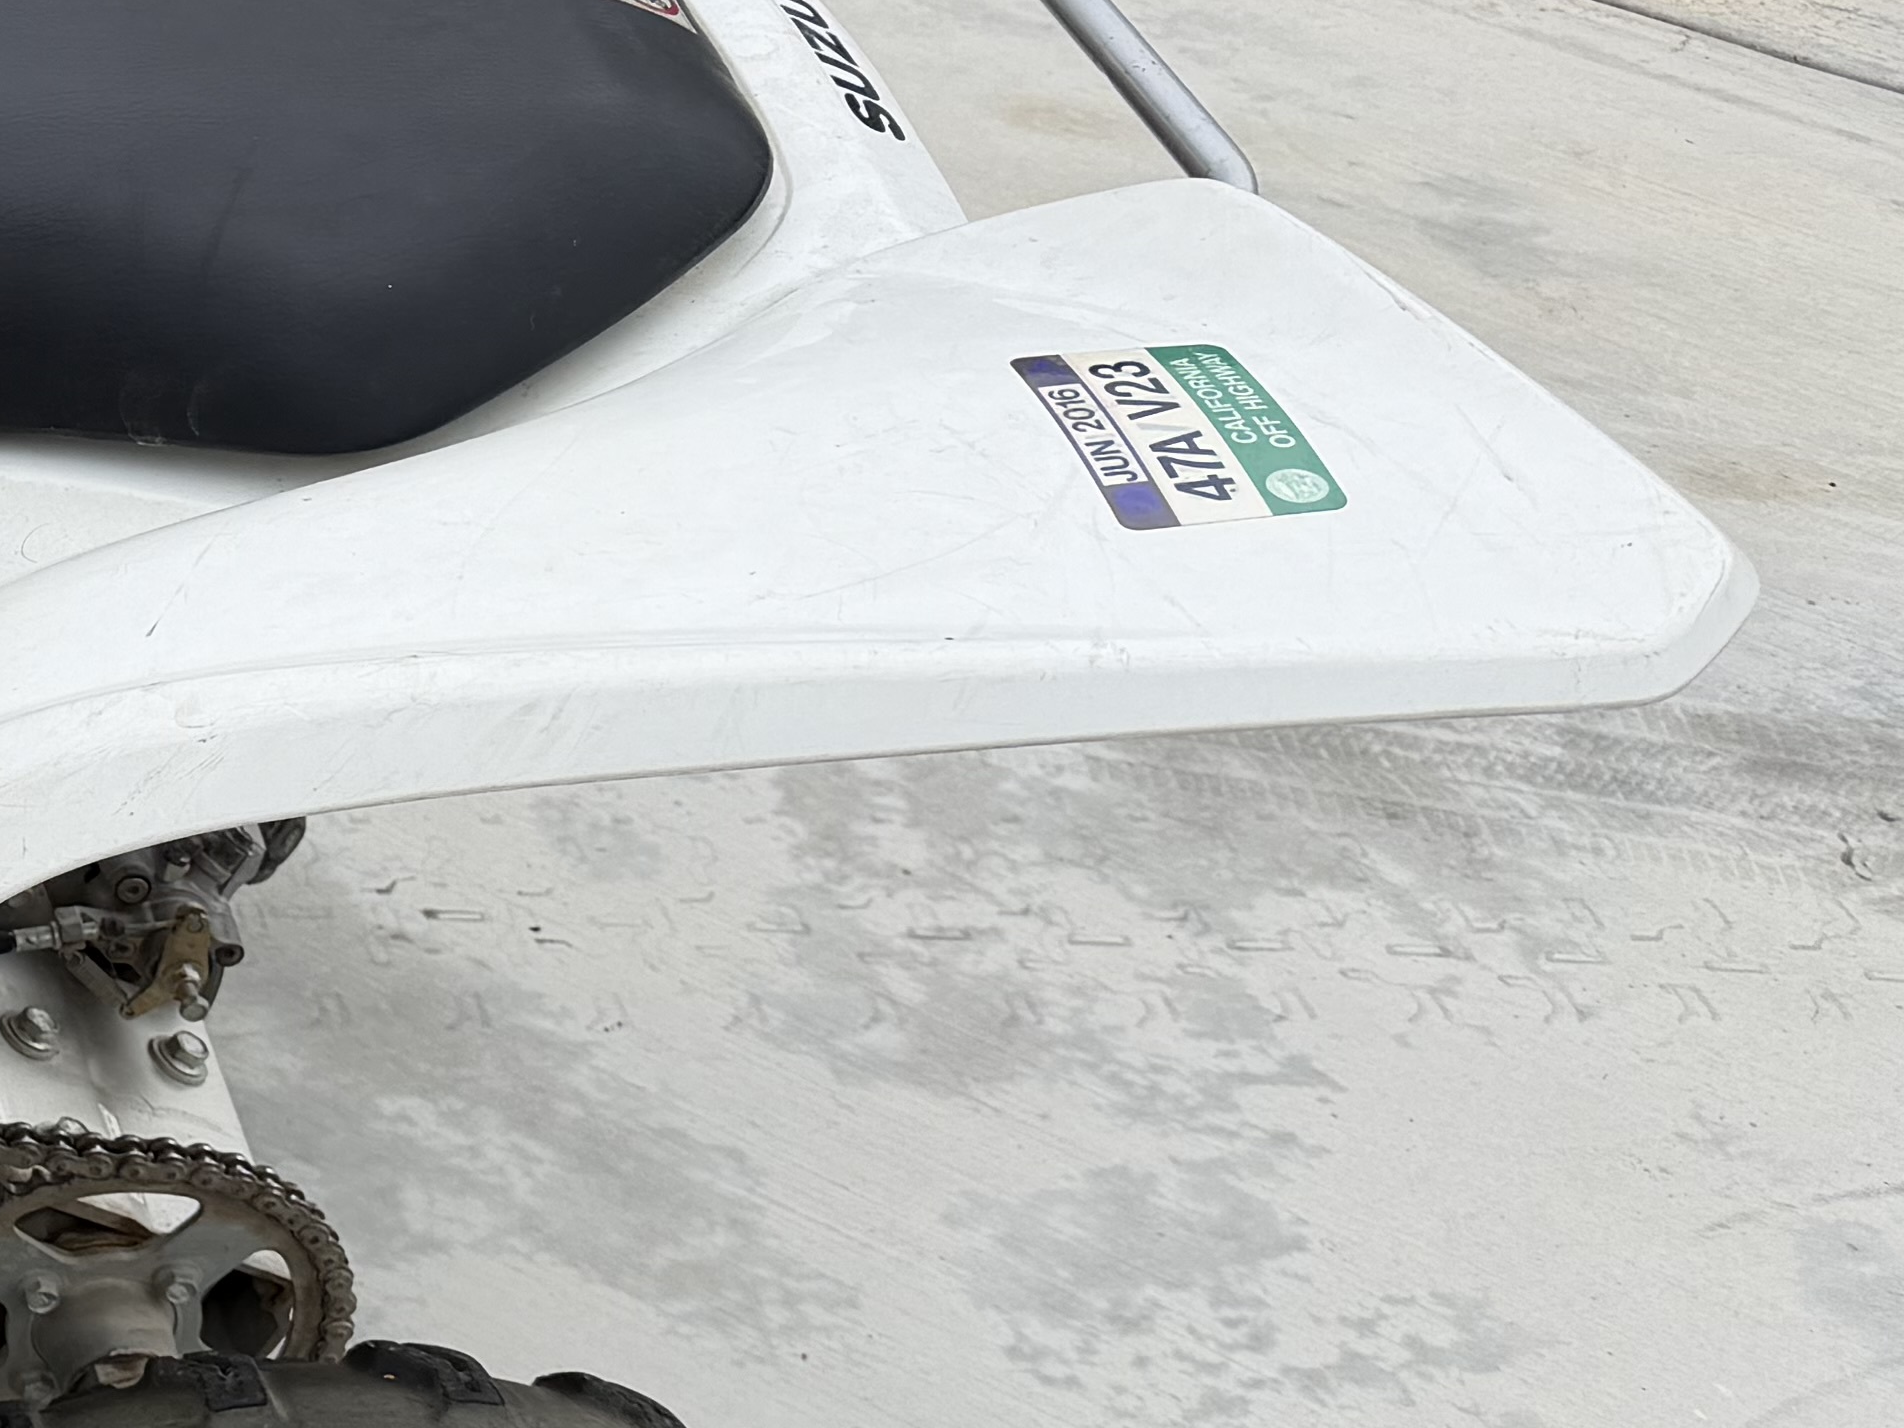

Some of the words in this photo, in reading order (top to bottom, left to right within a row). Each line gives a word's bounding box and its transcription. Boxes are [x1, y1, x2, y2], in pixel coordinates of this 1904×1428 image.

[1047, 388, 1103, 434] 2016
[1088, 360, 1181, 421] V23
[1169, 357, 1258, 445] CALIFORNIA
[1205, 352, 1268, 414] HIGHWAY
[1086, 438, 1138, 484] JUN
[1253, 415, 1296, 450] OFF
[1149, 430, 1234, 503] 47A
